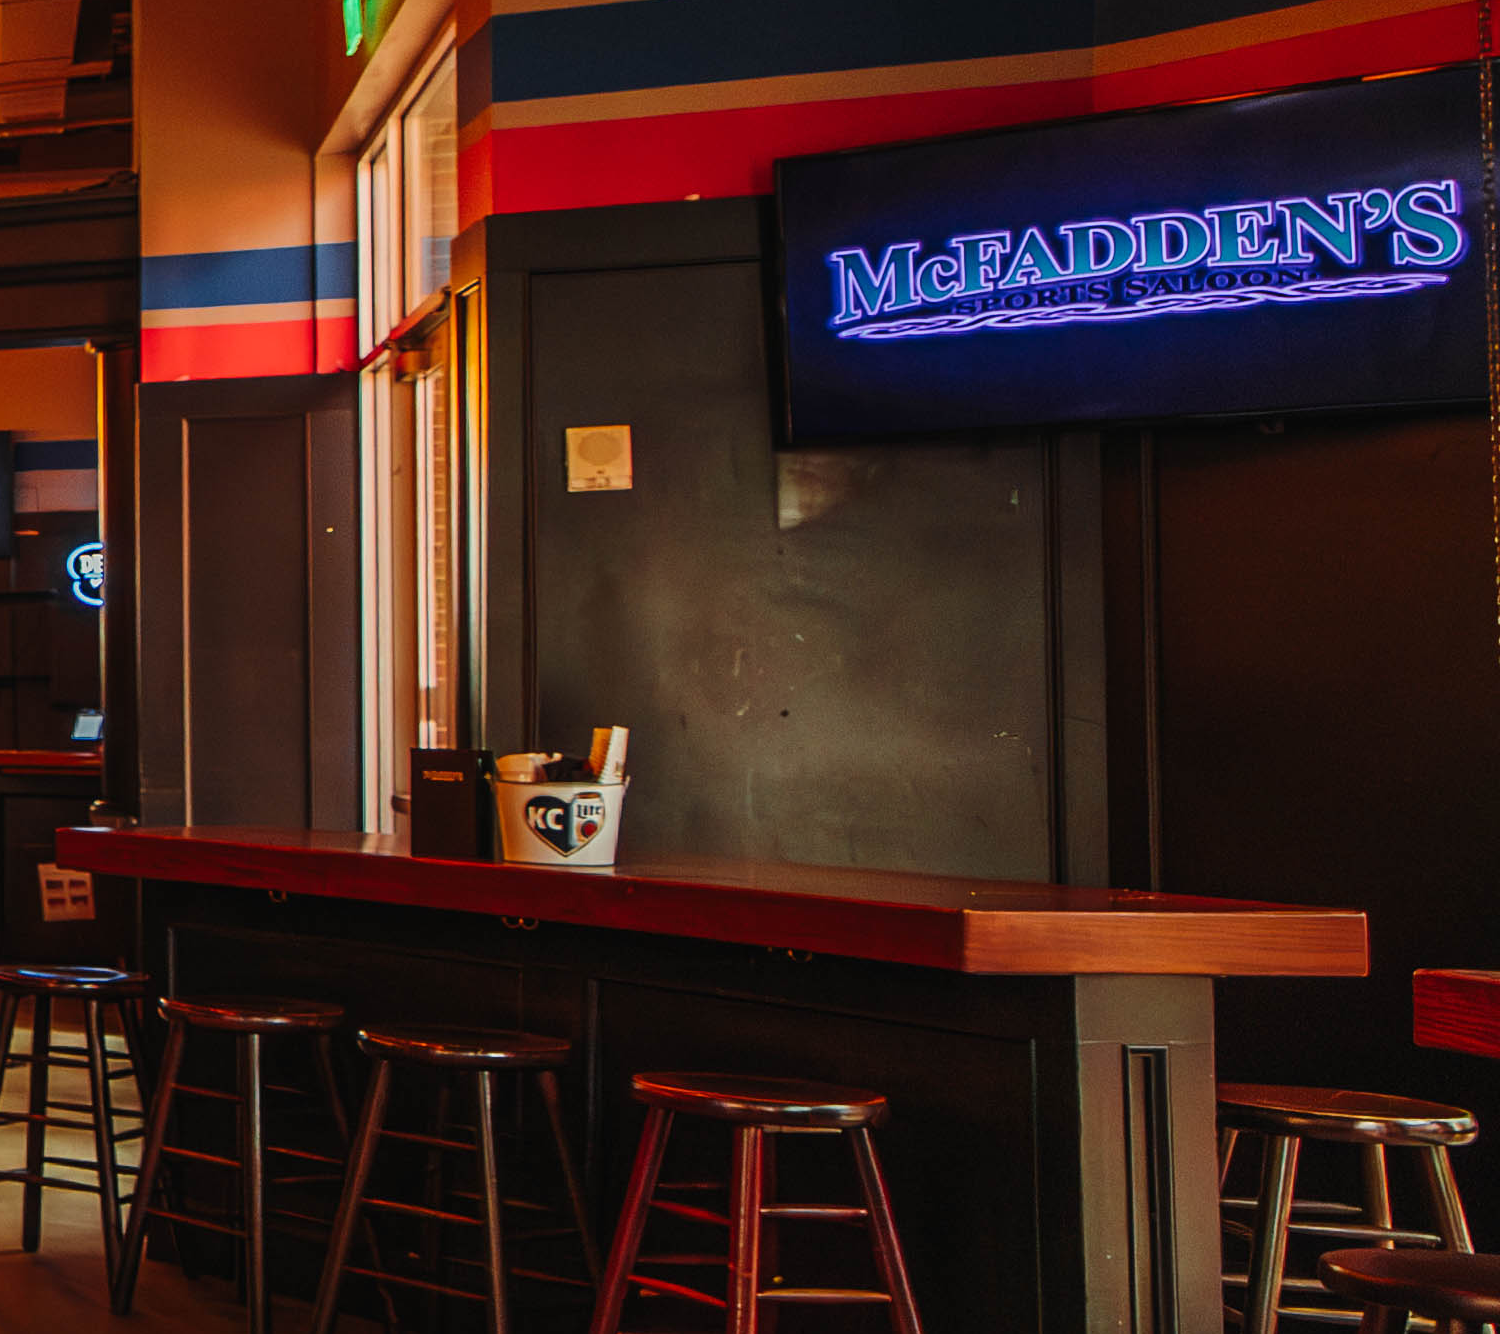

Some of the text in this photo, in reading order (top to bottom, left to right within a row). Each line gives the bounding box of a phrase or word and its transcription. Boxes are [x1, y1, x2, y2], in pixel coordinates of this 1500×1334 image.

[829, 178, 1466, 326] McFADDEN'S
[953, 268, 1310, 316] SPORTS SALOON
[528, 806, 564, 830] KC
